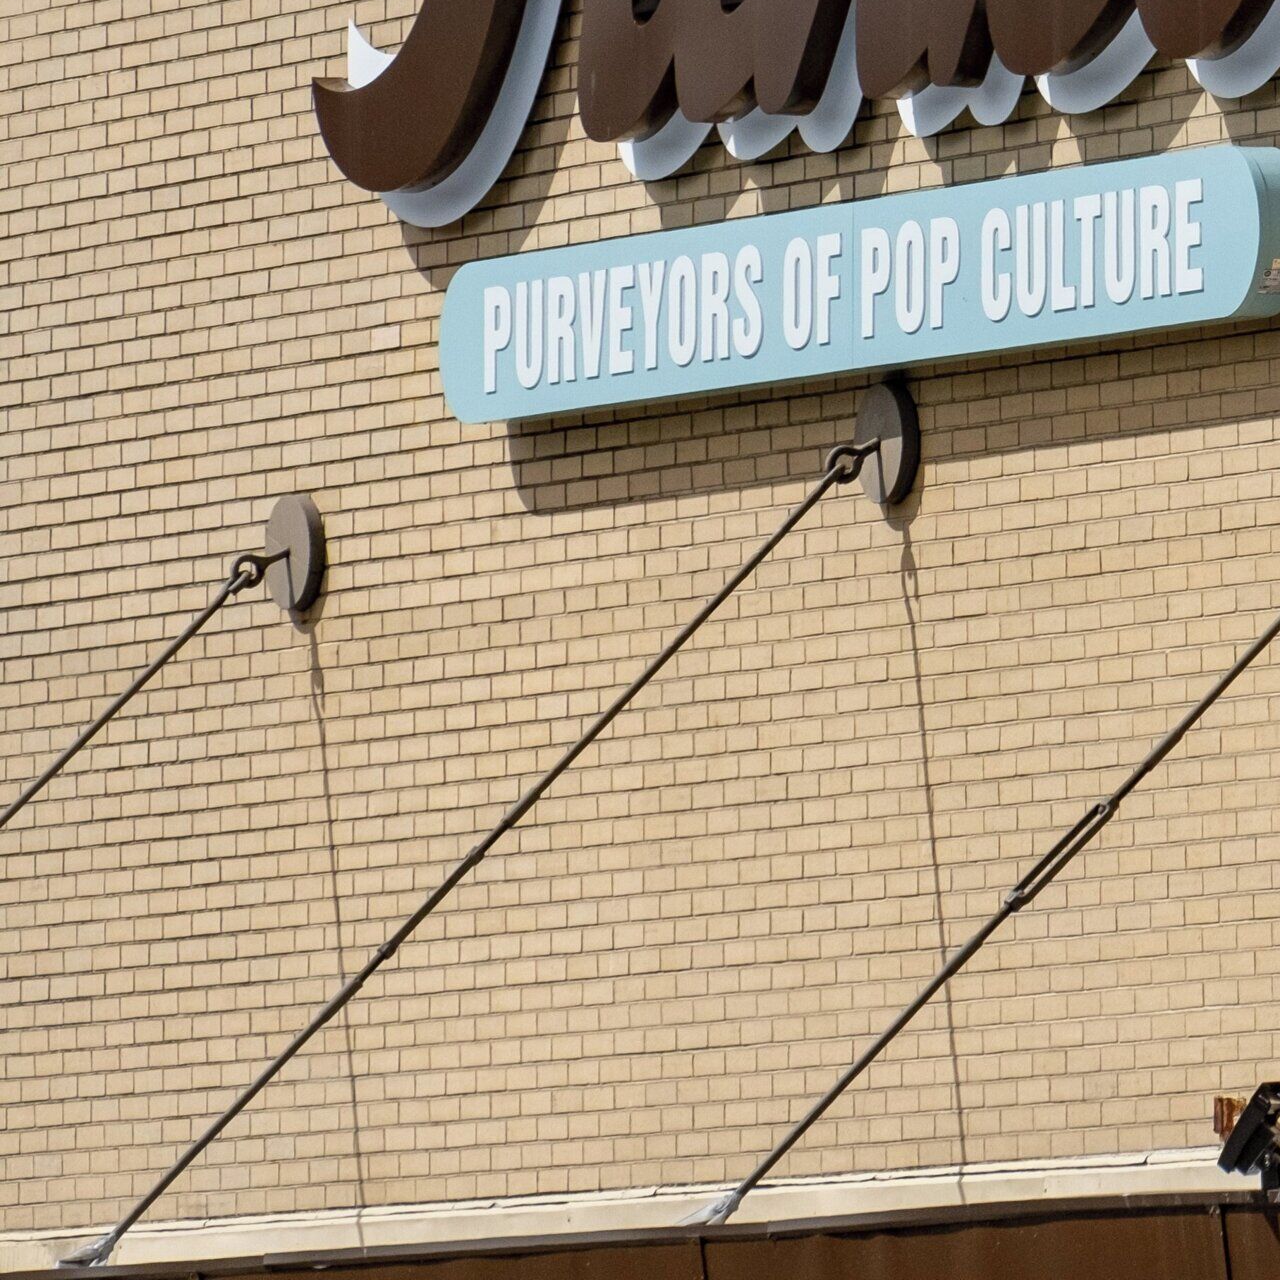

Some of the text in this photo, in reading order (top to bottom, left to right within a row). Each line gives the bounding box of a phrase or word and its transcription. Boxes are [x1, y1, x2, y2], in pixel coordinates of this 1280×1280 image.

[483, 178, 1205, 394] PURVEYORS OF POP CULTURE
